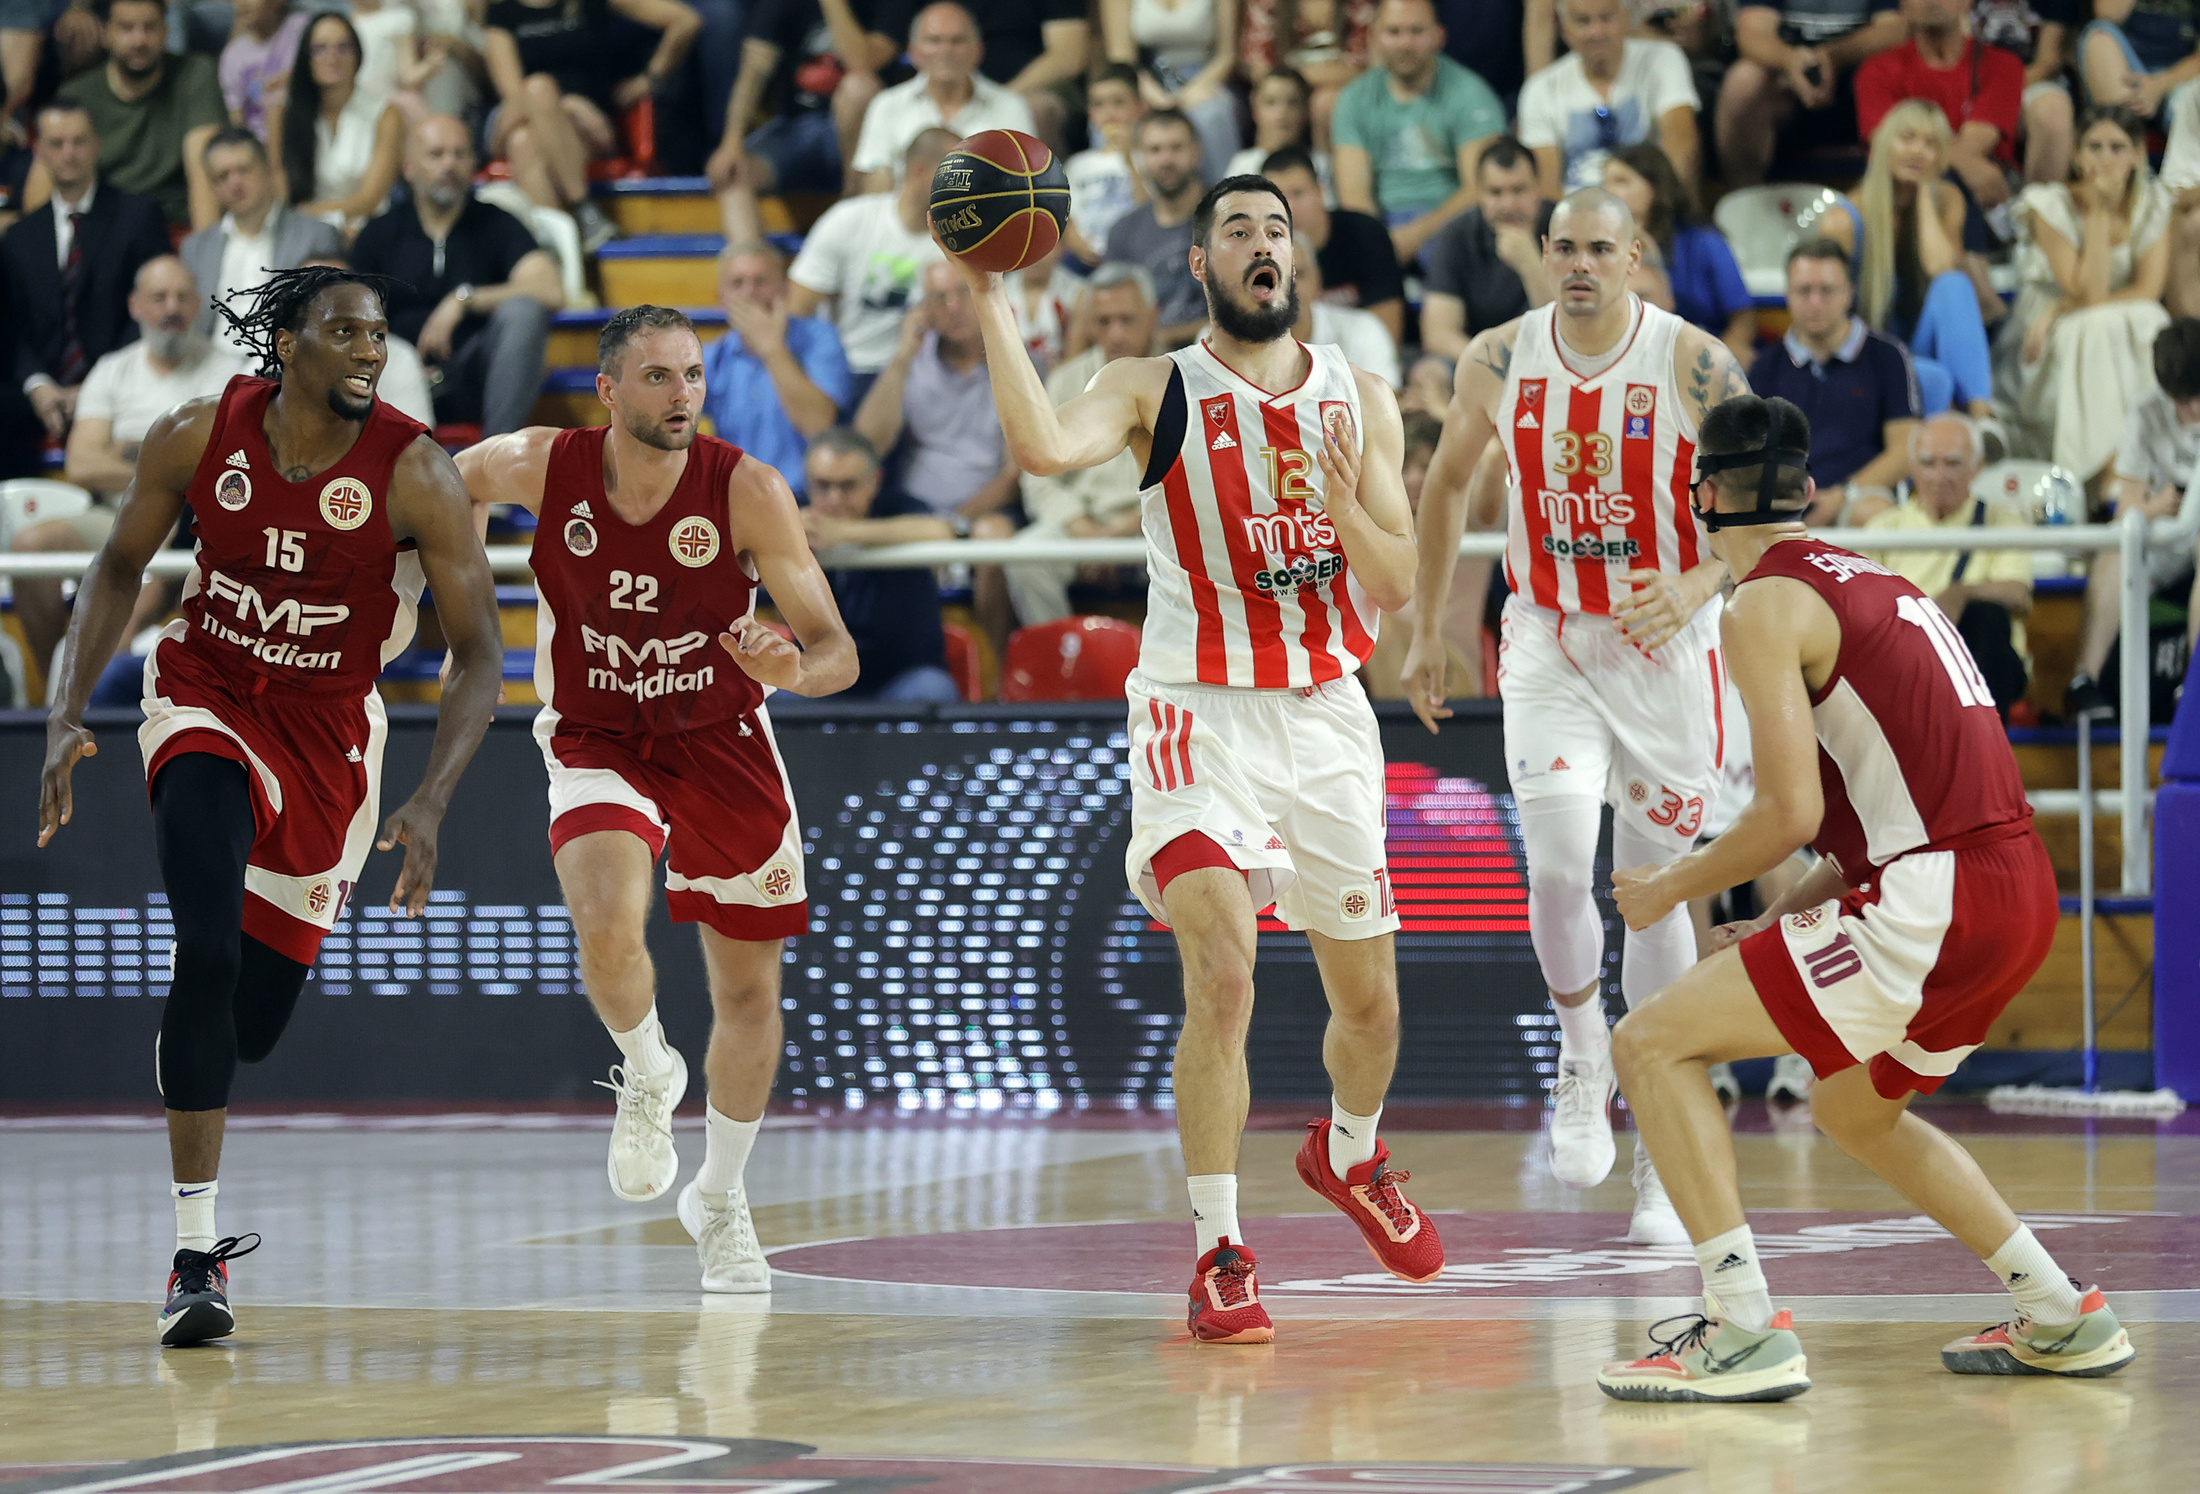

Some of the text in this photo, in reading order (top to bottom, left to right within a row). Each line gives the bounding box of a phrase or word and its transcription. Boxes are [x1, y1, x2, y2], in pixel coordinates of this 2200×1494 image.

[1259, 446, 1315, 499] 12
[1552, 430, 1613, 478] 33
[1537, 485, 1636, 526] mts
[262, 526, 307, 573] 15
[1243, 507, 1336, 553] mts
[1542, 534, 1642, 559] SOCCER
[609, 569, 659, 614] 22
[1255, 553, 1343, 591] SOCCER
[206, 570, 351, 636] FMP
[201, 611, 342, 670] meridian
[580, 623, 709, 669] FMP
[1895, 594, 1997, 708] 10
[1647, 784, 1704, 838] 33
[1802, 931, 1863, 989] 10
